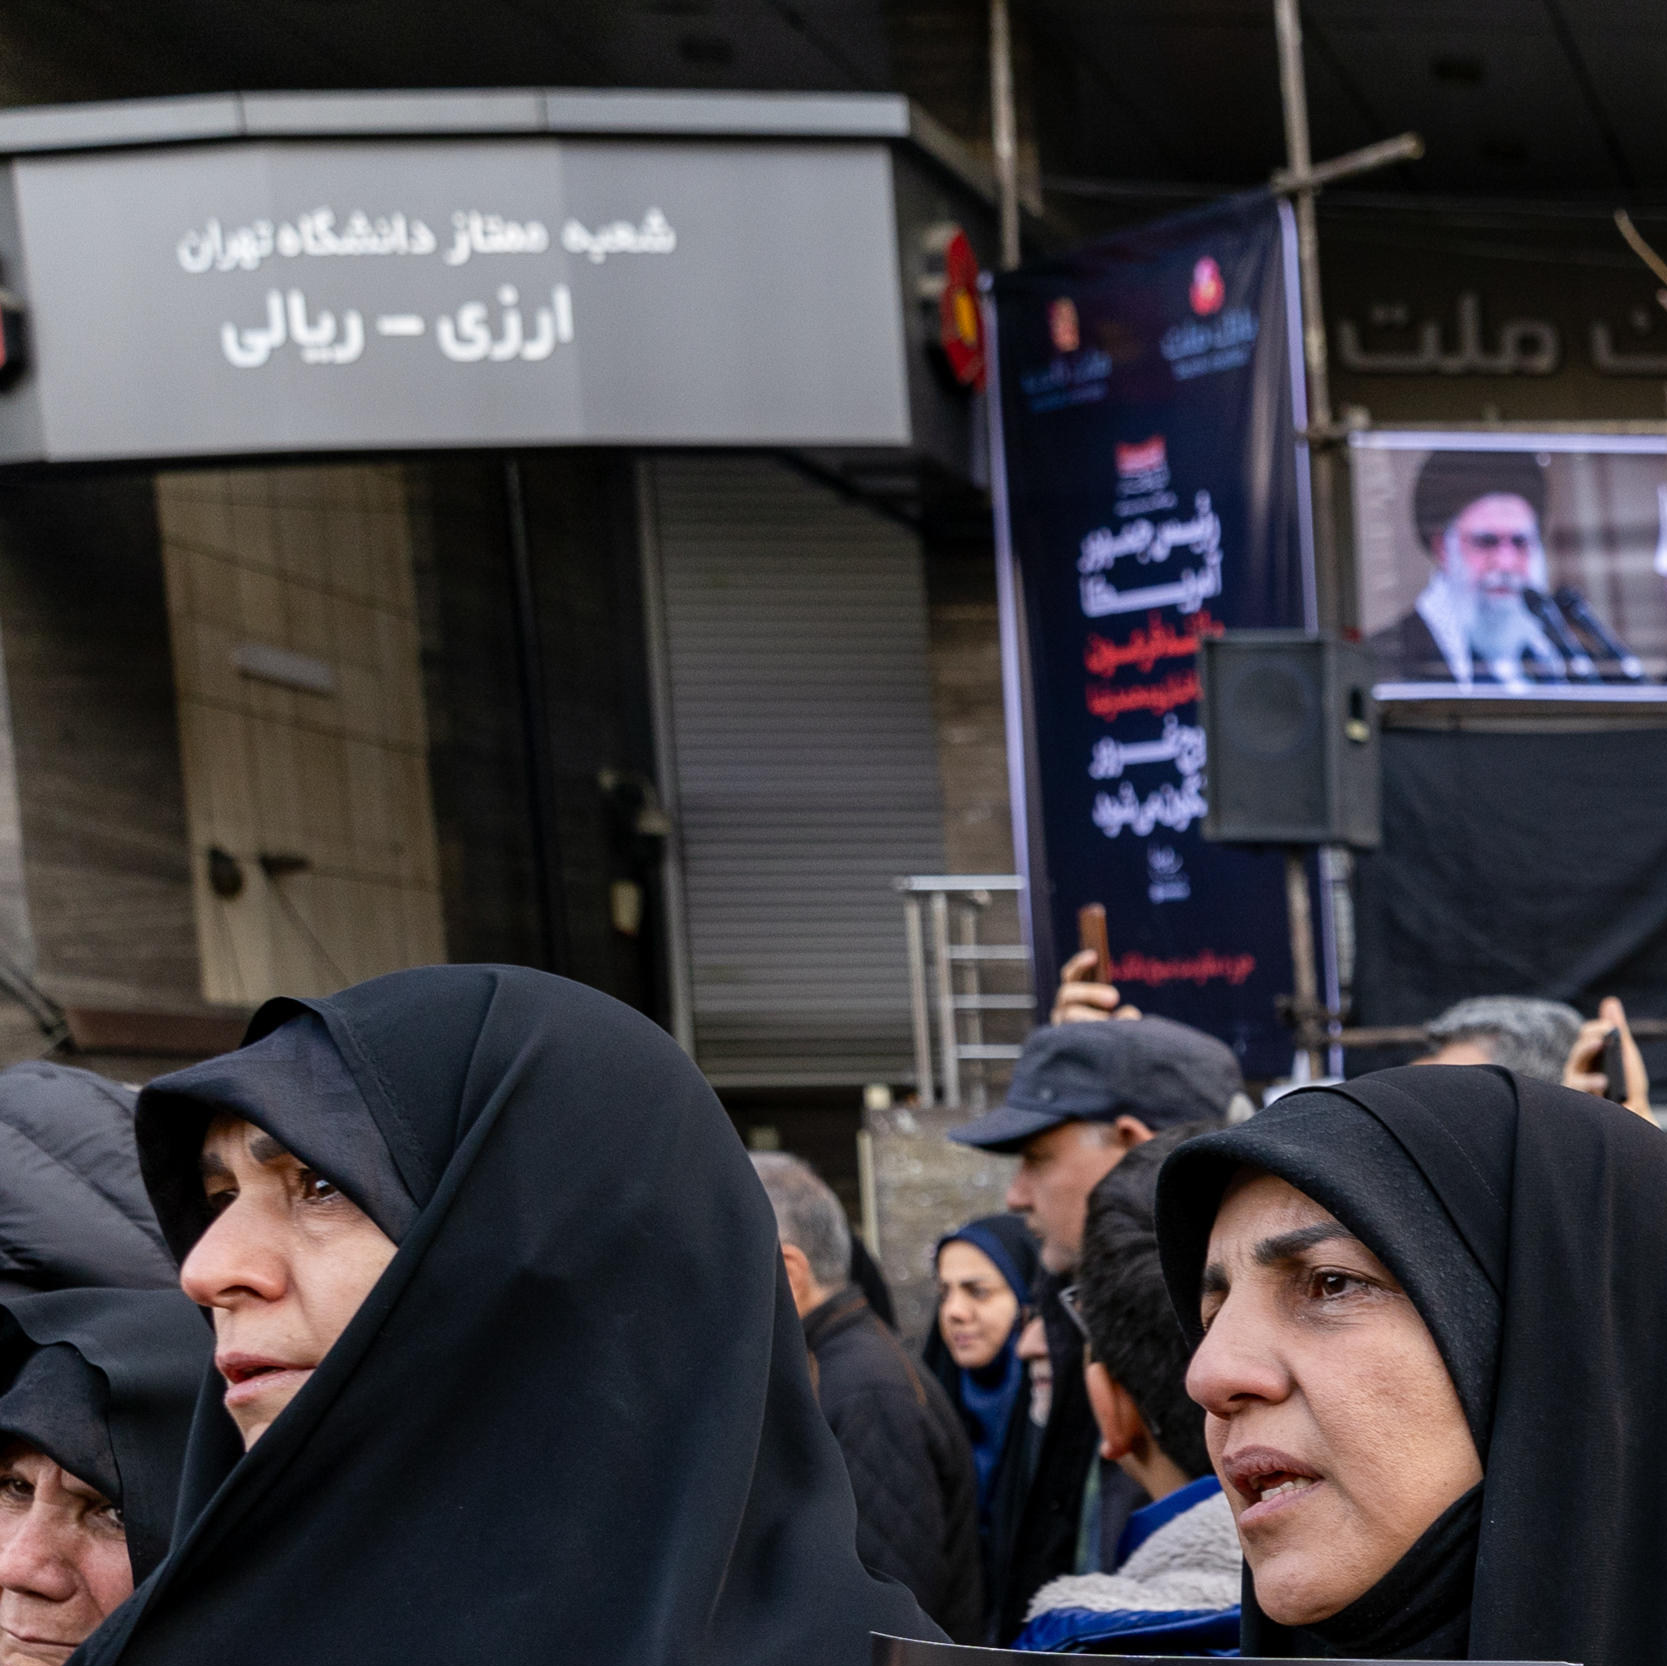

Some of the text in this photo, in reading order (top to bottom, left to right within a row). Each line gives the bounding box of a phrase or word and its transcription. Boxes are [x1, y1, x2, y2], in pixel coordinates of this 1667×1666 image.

[176, 206, 677, 273] شعبه ممتاز دانشگاه تهران
[220, 288, 365, 367] ریالی
[436, 283, 574, 362] ارزی
[1337, 292, 1561, 375] ملت
